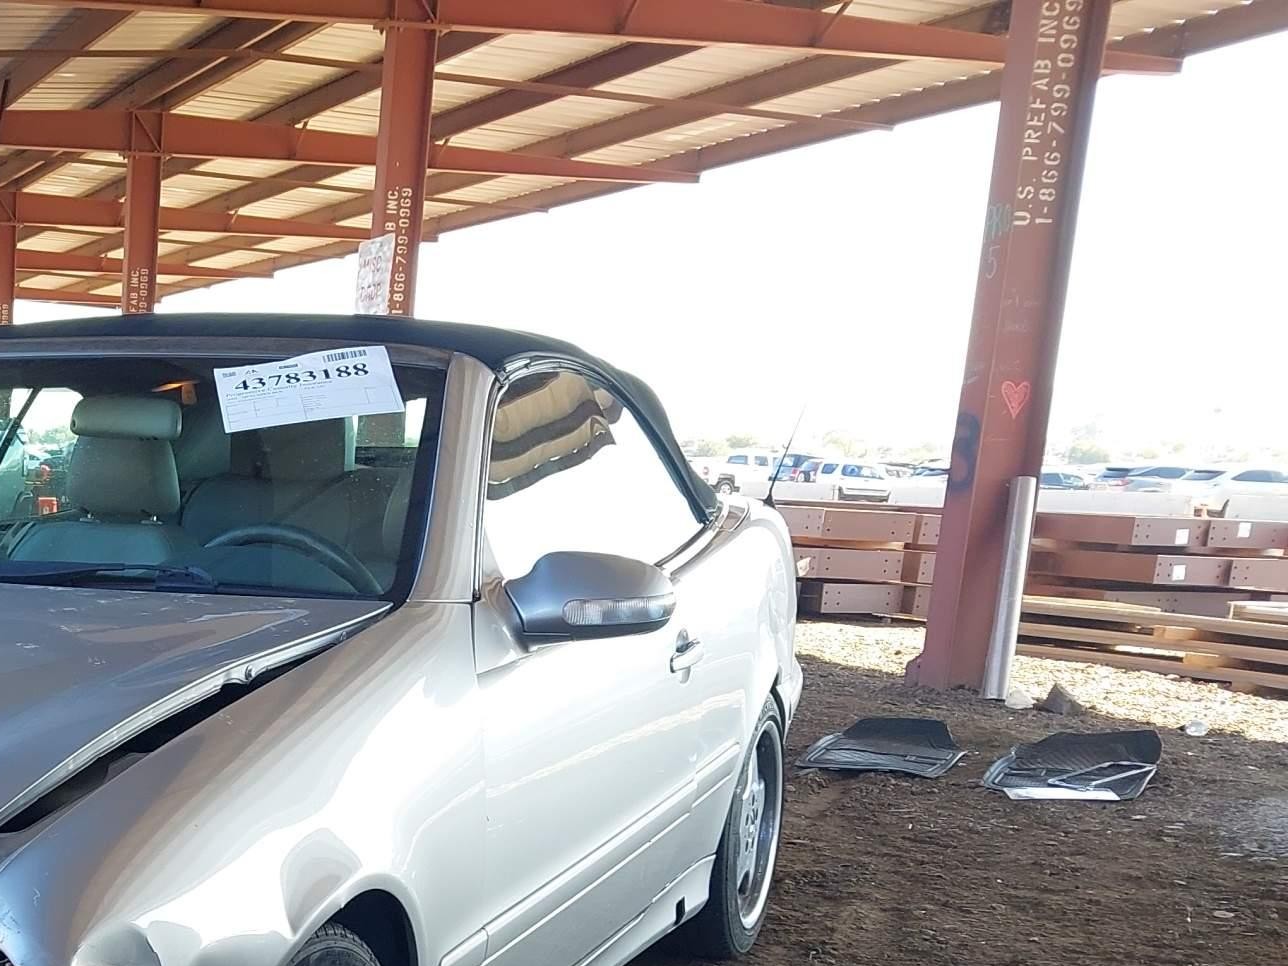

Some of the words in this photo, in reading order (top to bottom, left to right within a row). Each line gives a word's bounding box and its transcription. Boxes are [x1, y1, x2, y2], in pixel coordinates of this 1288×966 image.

[387, 186, 400, 214] INC.
[1013, 177, 1035, 226] U.S.
[391, 187, 412, 315] 1-866-799-0969
[234, 362, 369, 391] 43783188
